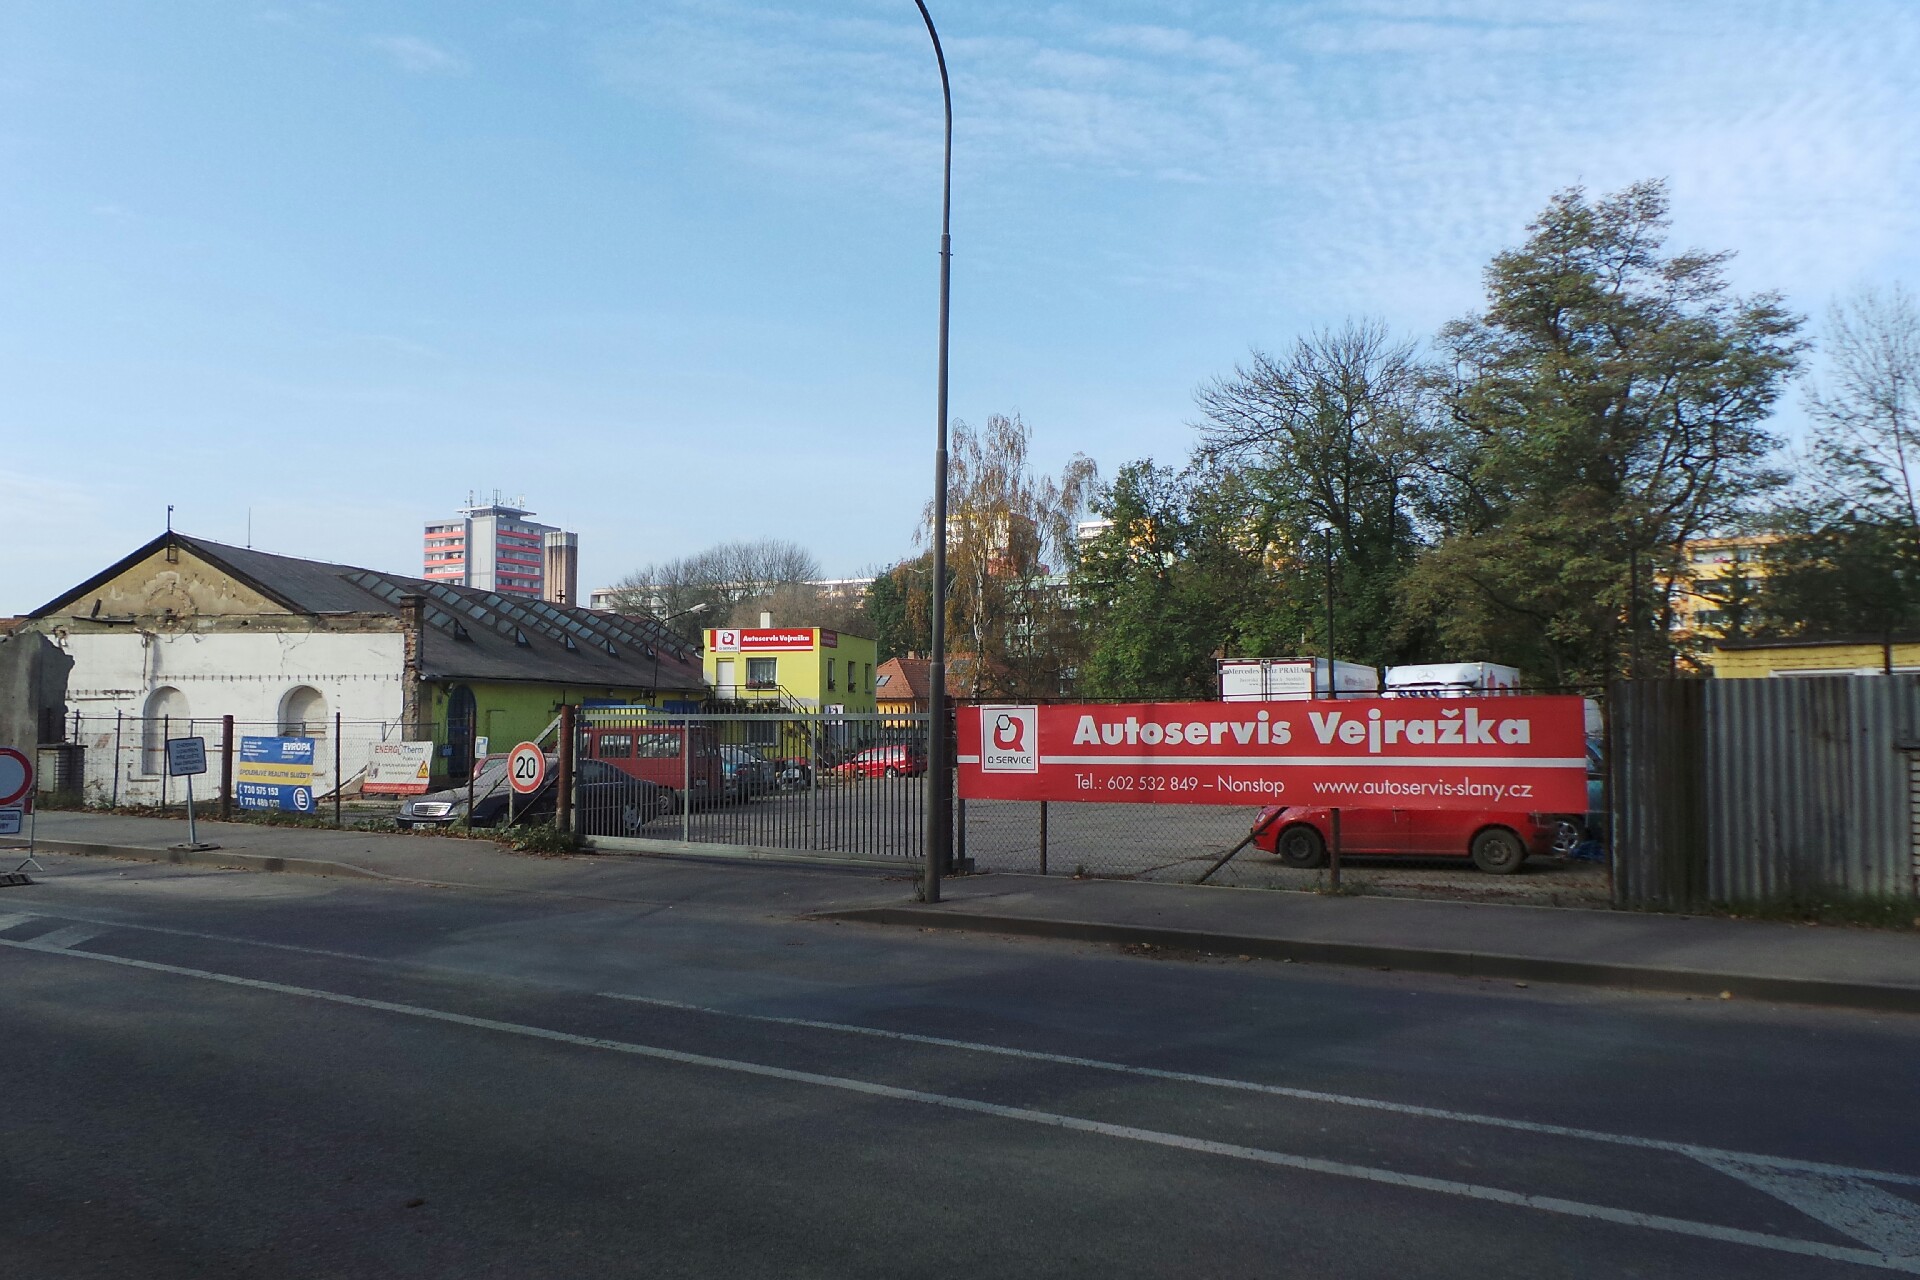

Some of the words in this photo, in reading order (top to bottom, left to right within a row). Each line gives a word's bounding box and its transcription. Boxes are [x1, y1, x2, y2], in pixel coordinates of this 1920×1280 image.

[779, 634, 810, 643] Vejražka
[1073, 710, 1292, 745] Autoservis
[1308, 707, 1530, 753] Vejražka
[283, 742, 311, 751] EVROPA
[516, 756, 535, 778] 20
[244, 786, 255, 795] 730
[256, 786, 267, 795] 575
[268, 787, 279, 796] 153
[1075, 773, 1102, 790] Tel.:
[1107, 775, 1134, 791] 602
[1139, 776, 1166, 791] 532
[1170, 777, 1198, 791] 849
[1218, 776, 1285, 797] Nonstop
[1313, 777, 1534, 802] www.autoservis-slany.cz
[245, 797, 256, 806] 774
